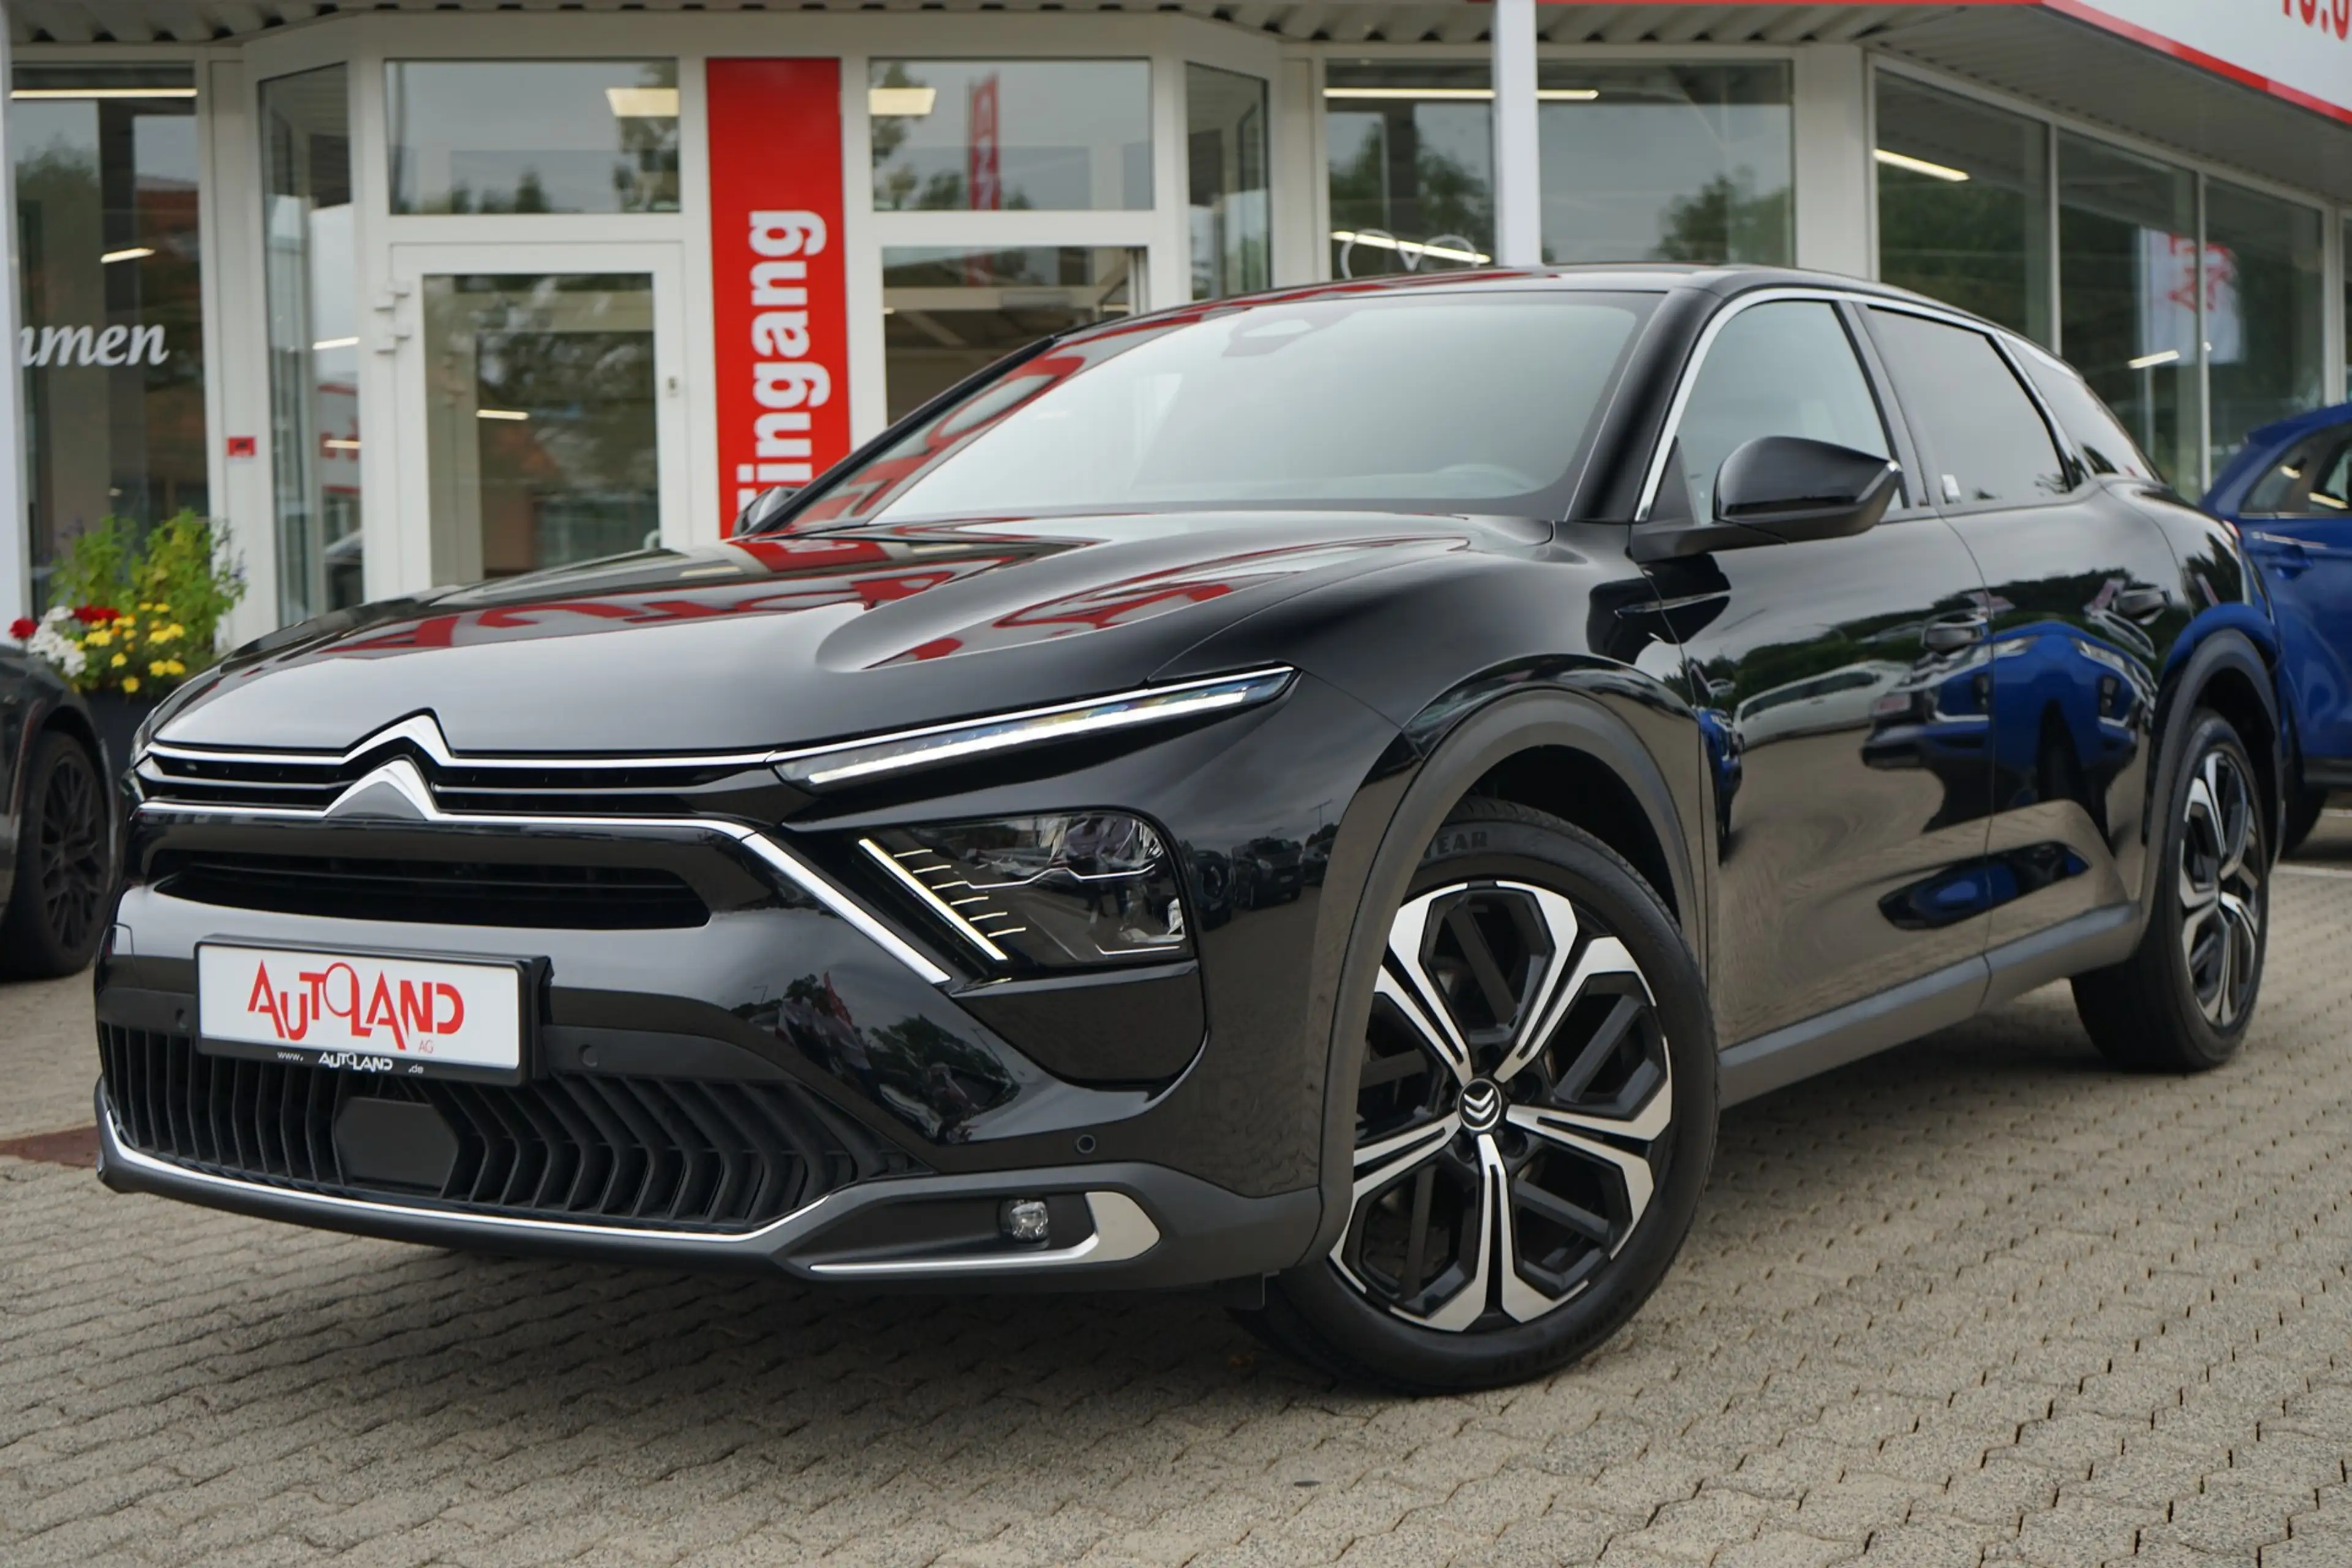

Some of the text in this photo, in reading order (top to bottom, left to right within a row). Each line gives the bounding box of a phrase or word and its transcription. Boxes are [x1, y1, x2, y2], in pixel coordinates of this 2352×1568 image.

[737, 210, 831, 513] ingang
[1424, 831, 1487, 859] EAR
[418, 1039, 434, 1054] AG
